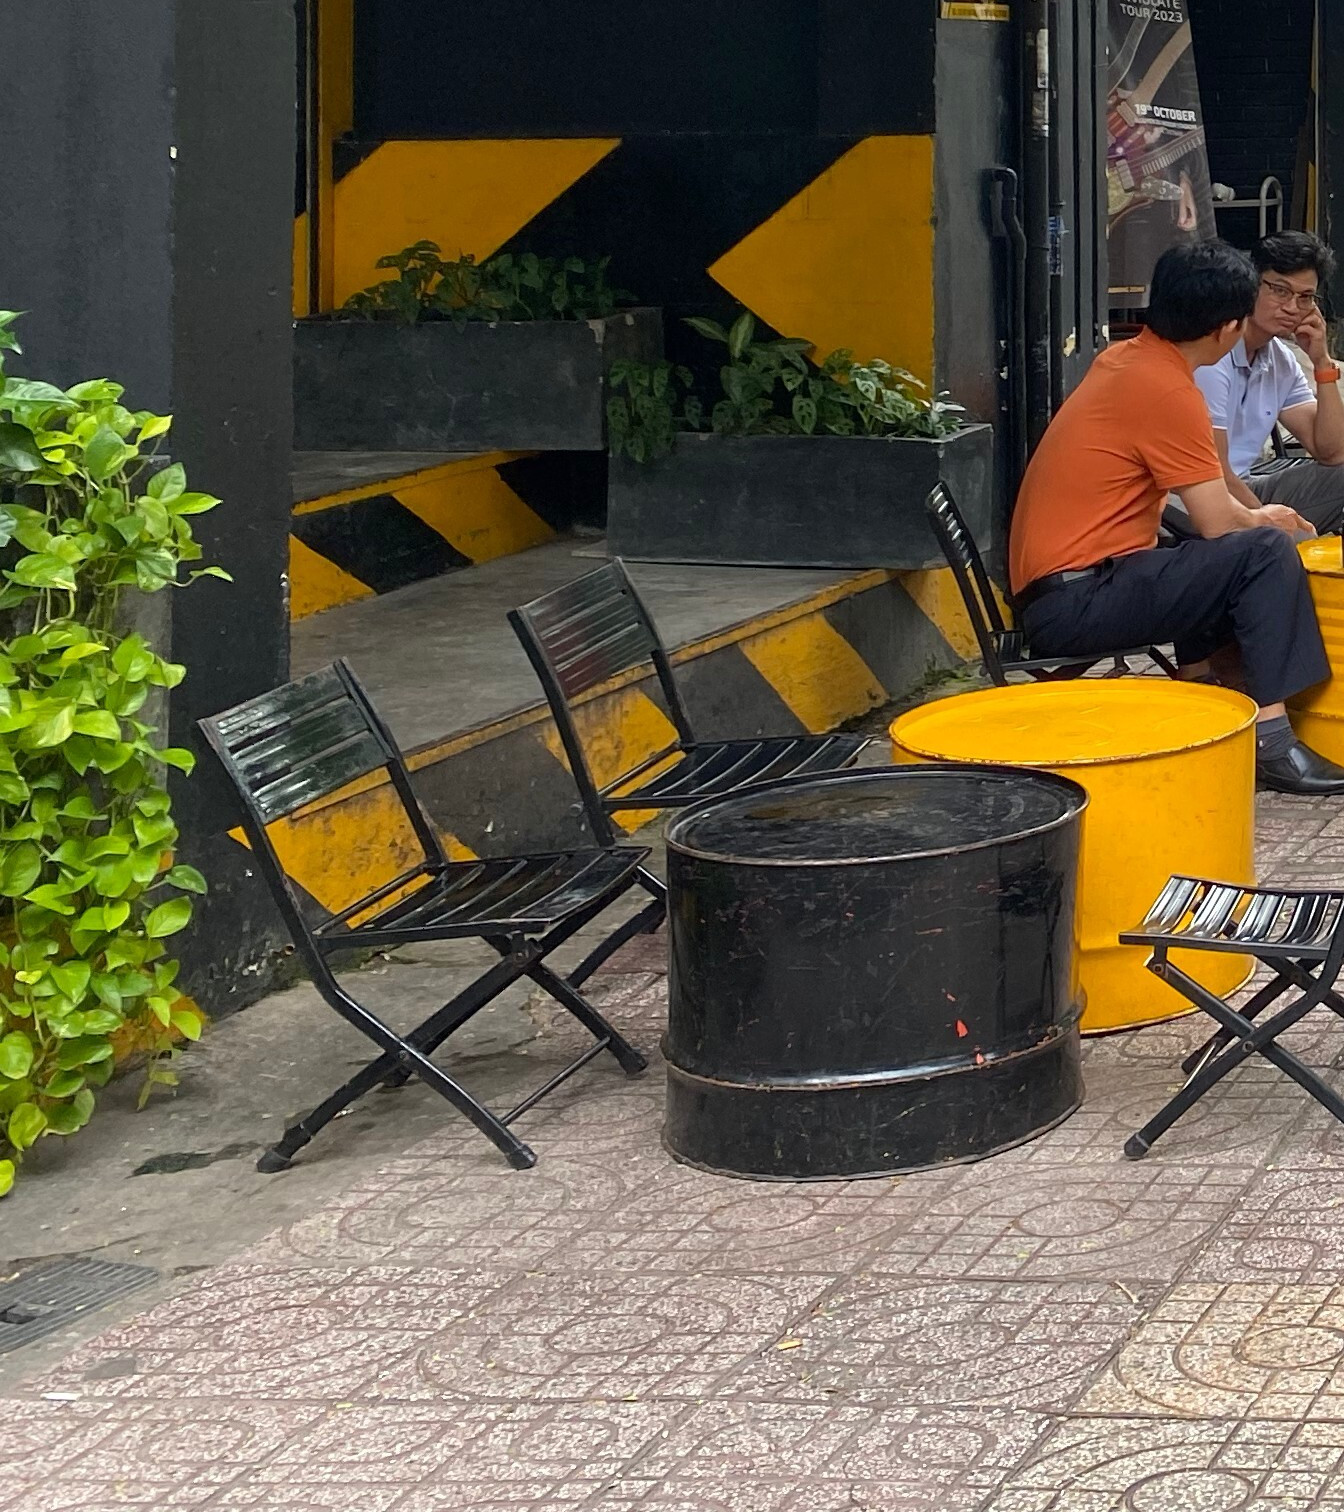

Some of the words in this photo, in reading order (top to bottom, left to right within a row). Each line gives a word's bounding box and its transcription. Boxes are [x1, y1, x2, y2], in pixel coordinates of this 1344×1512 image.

[1119, 3, 1151, 19] TOUR
[1153, 8, 1183, 23] 2023
[1153, 105, 1197, 122] OCTOBER
